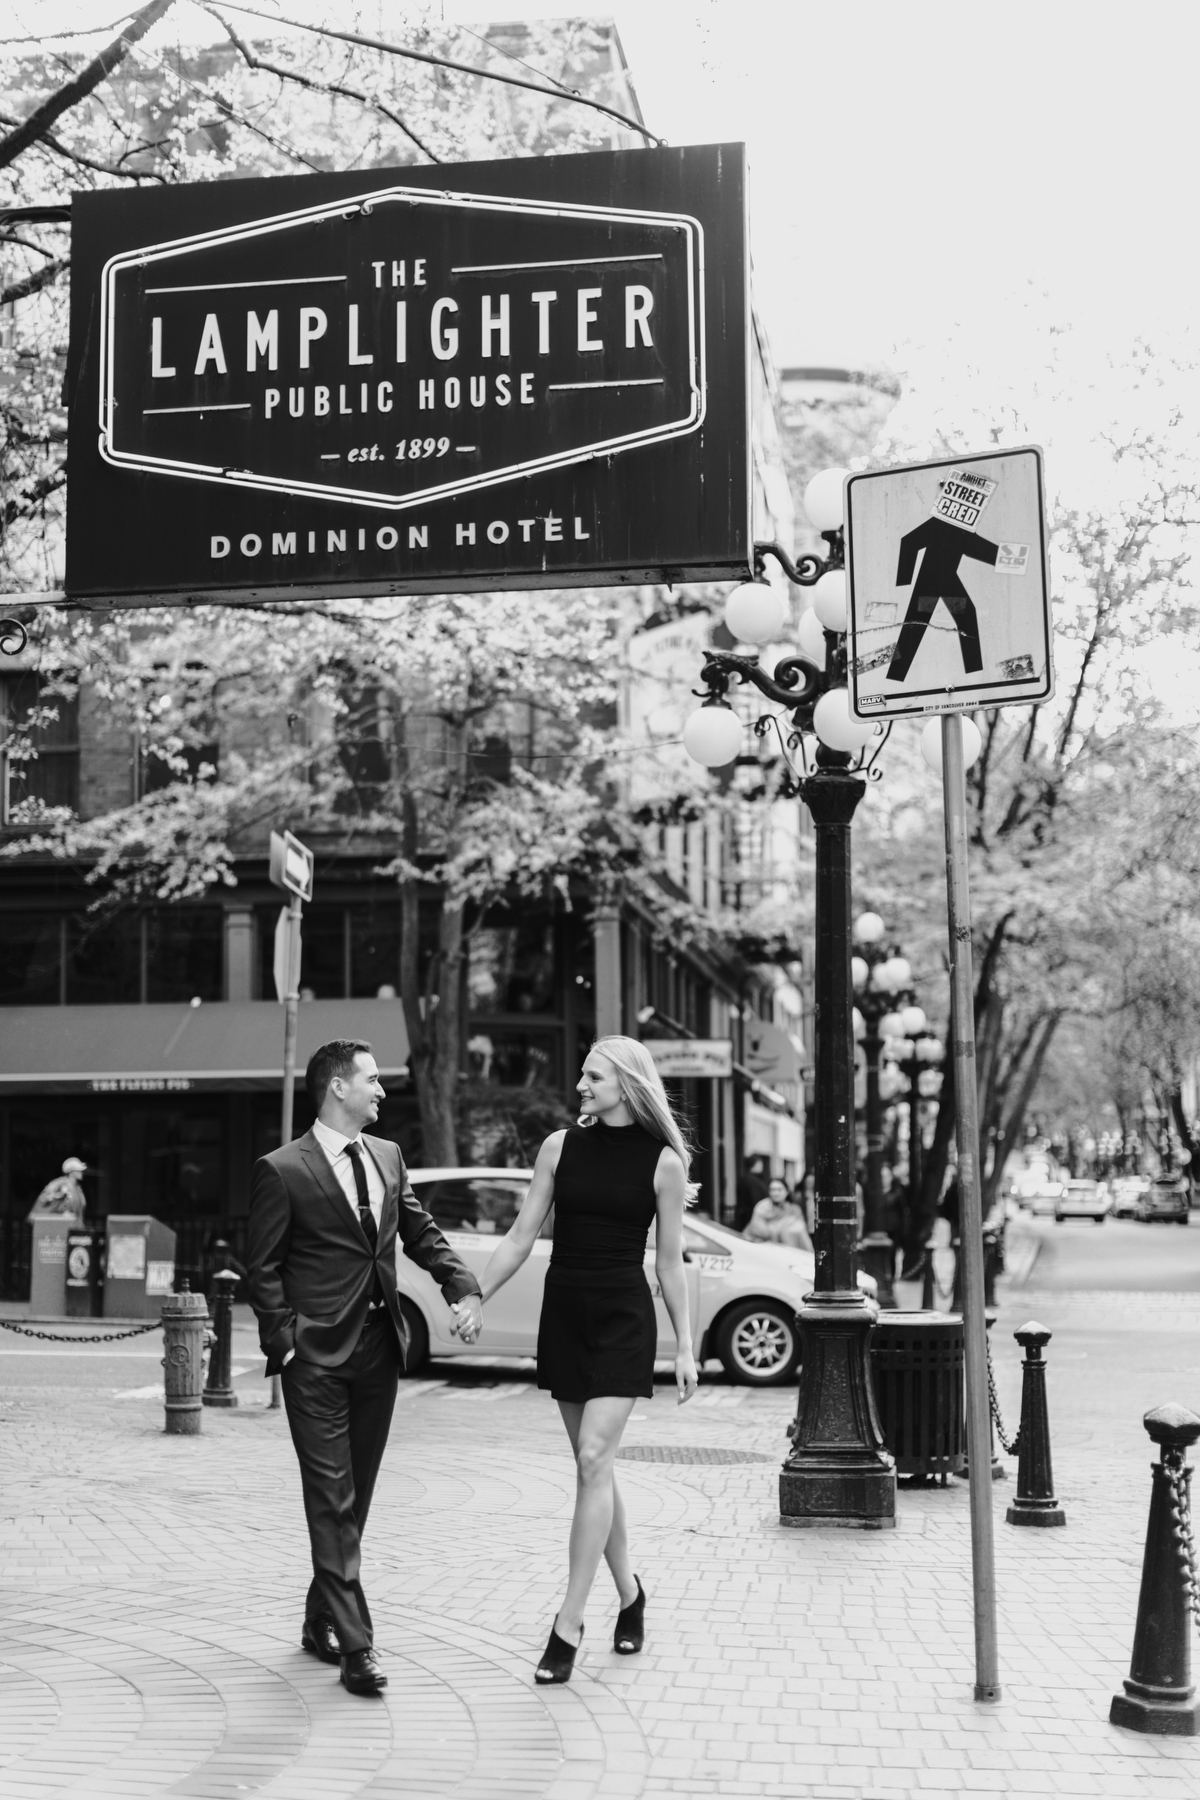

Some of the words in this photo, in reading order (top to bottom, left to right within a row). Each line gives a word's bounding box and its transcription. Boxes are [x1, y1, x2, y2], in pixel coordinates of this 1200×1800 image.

[371, 258, 427, 288] THE
[151, 284, 655, 378] LAMPLIGHTER
[263, 380, 394, 419] PUBLIC
[419, 372, 535, 410] HOUSE
[347, 444, 385, 463] est.
[395, 436, 450, 460] 1899
[944, 481, 989, 507] STREET
[939, 498, 979, 525] CRED
[210, 525, 428, 560] DOMINION
[455, 512, 590, 546] HOTEL
[861, 697, 881, 706] MARV
